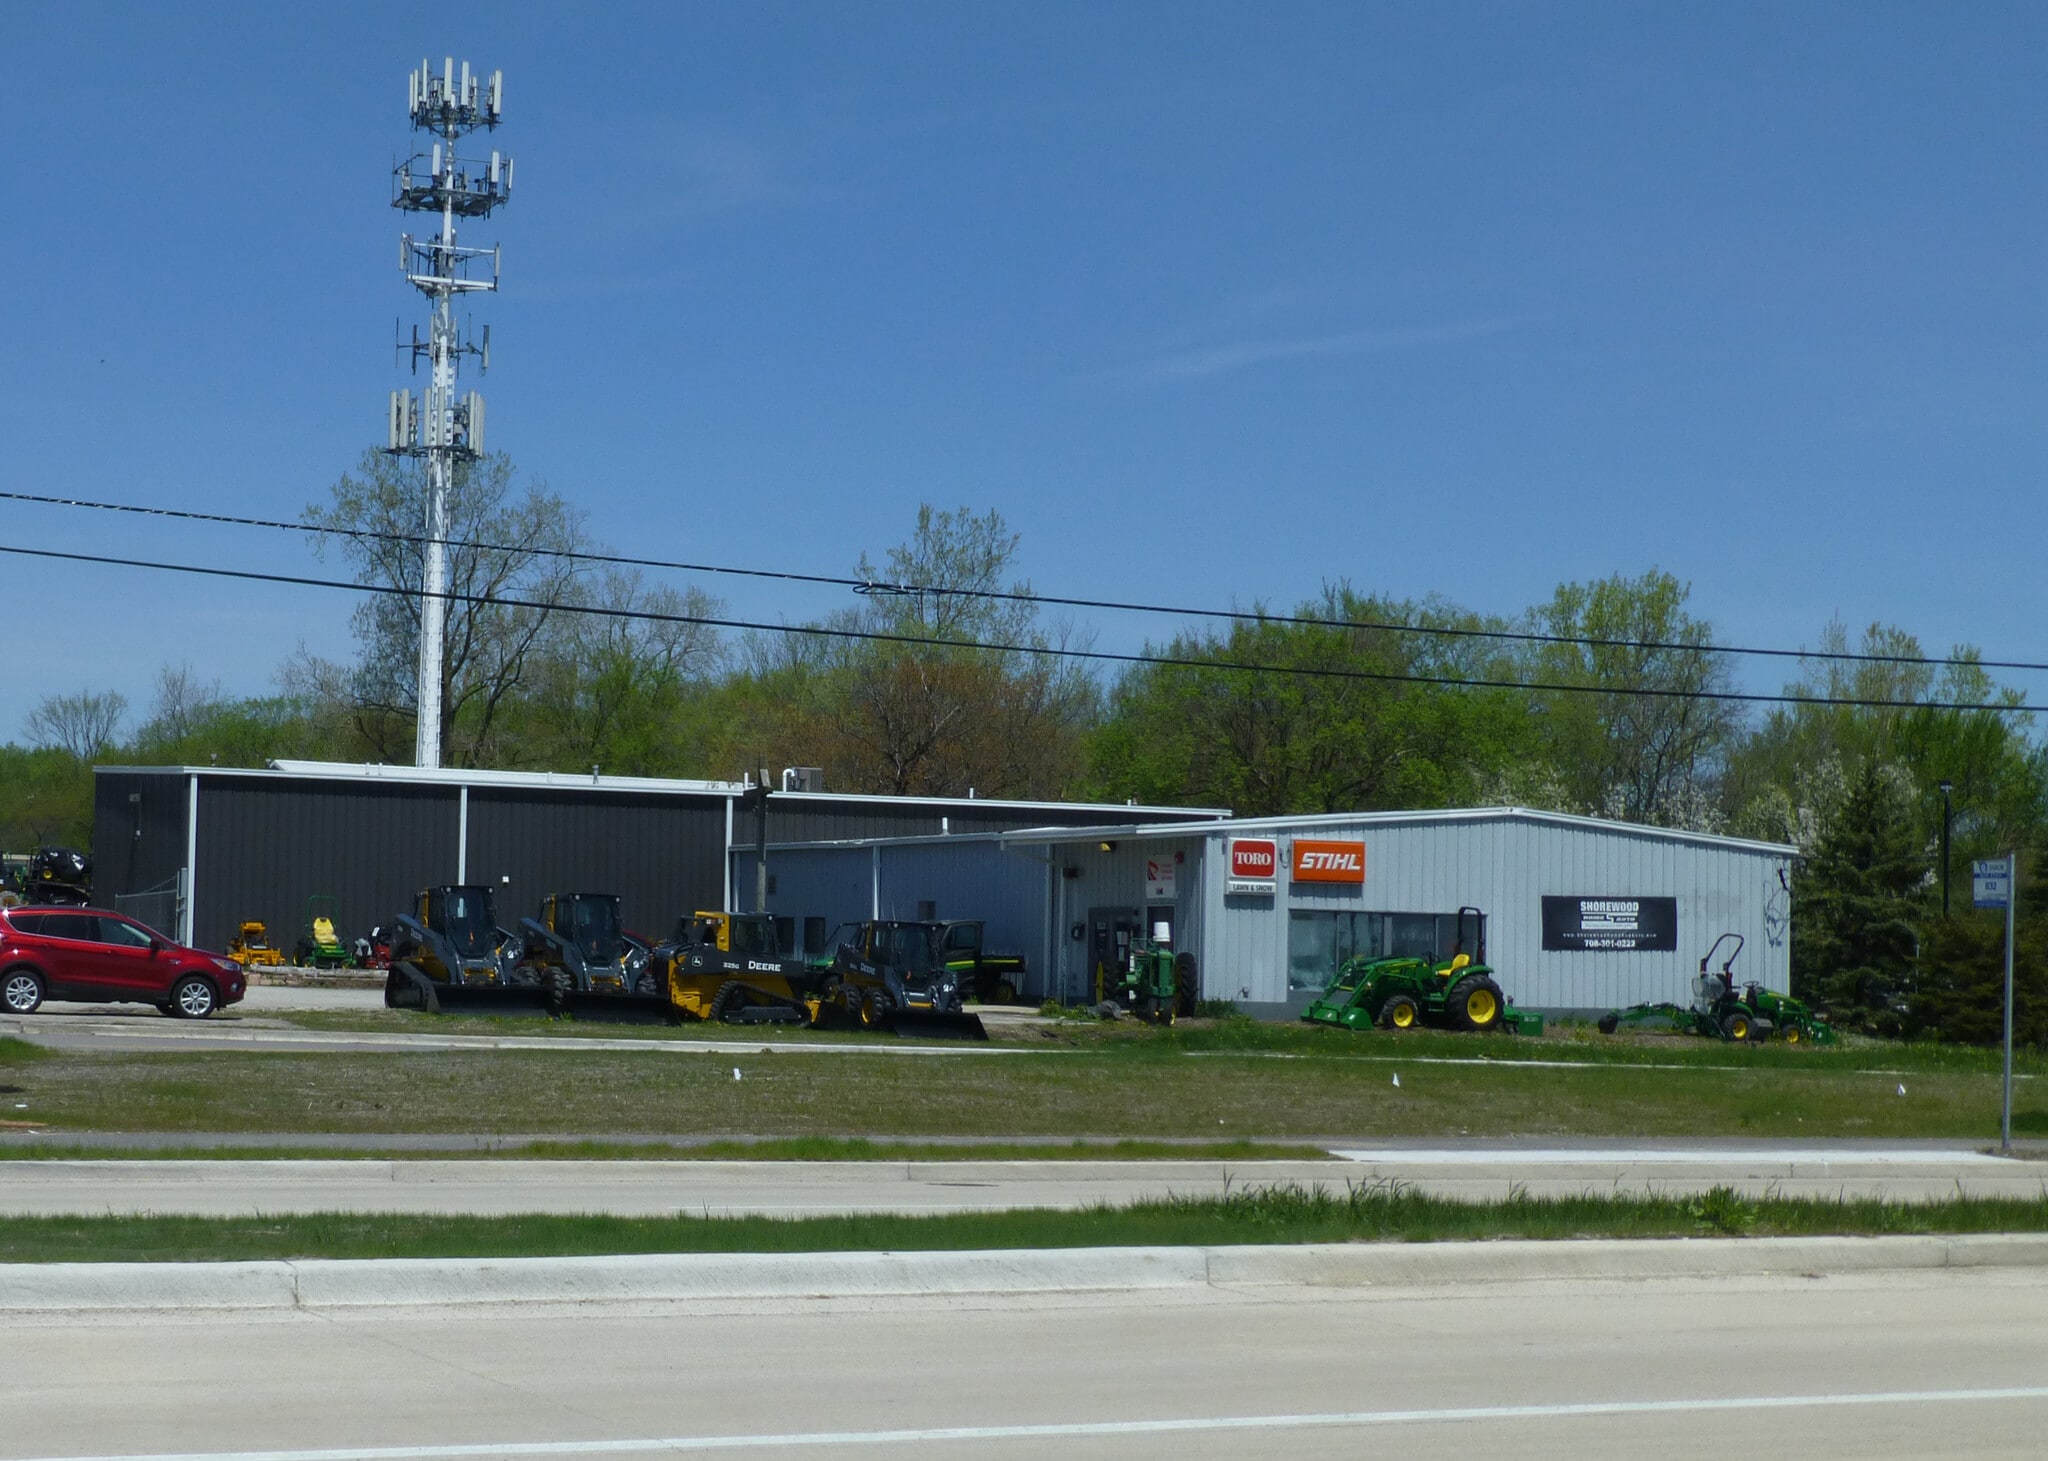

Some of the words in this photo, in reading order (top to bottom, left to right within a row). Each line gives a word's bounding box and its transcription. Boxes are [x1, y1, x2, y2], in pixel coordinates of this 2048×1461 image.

[1234, 851, 1271, 866] TORO
[1299, 852, 1360, 870] STIHL
[1580, 901, 1639, 912] SHOREWOOD
[748, 960, 782, 972] DEERE
